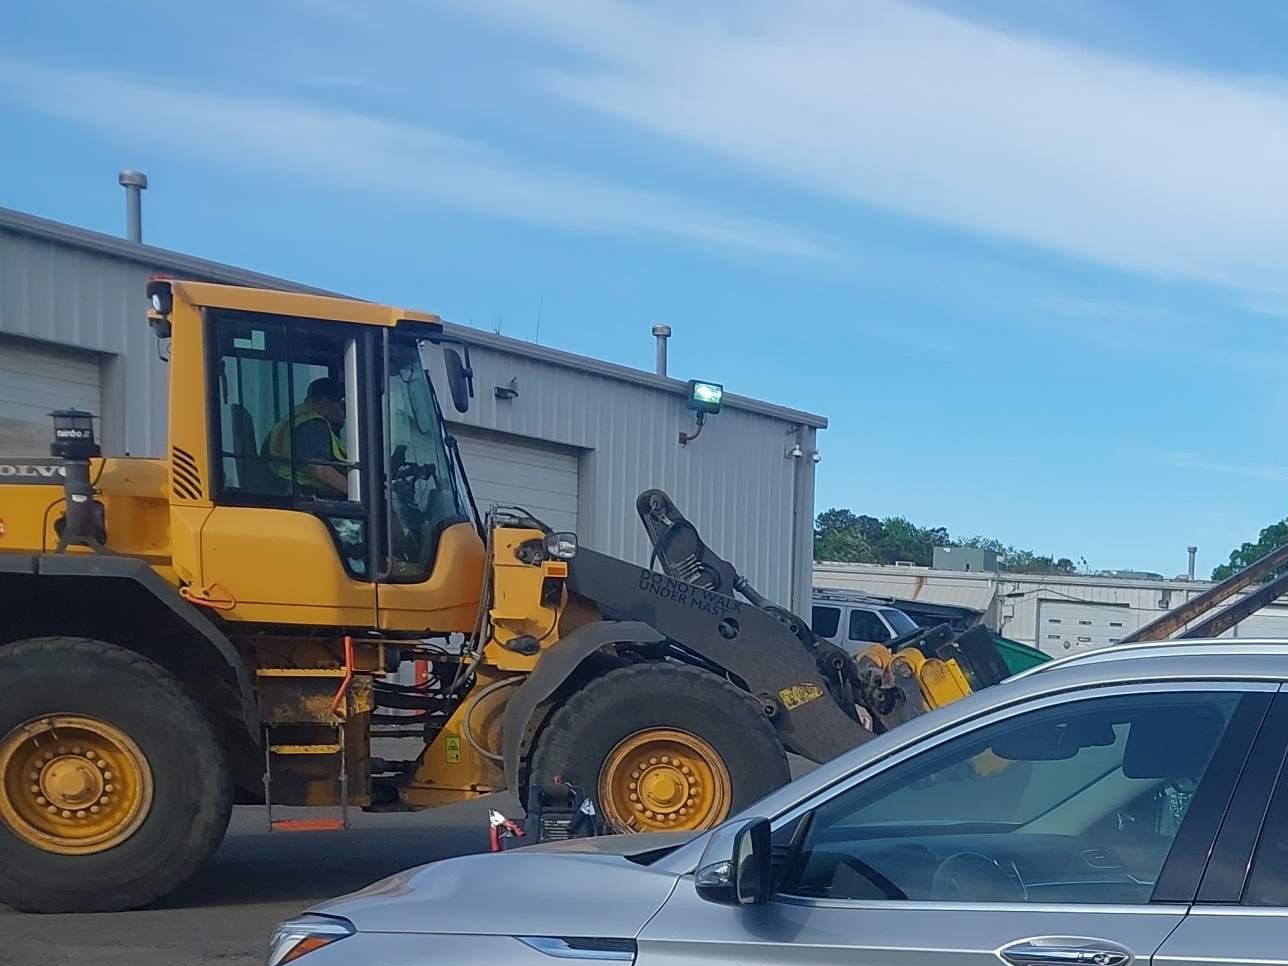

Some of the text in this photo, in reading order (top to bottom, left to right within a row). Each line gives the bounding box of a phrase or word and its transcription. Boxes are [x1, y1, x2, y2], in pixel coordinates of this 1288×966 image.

[640, 569, 741, 613] DO NOT WALK
[640, 579, 729, 618] UNDER MAST
